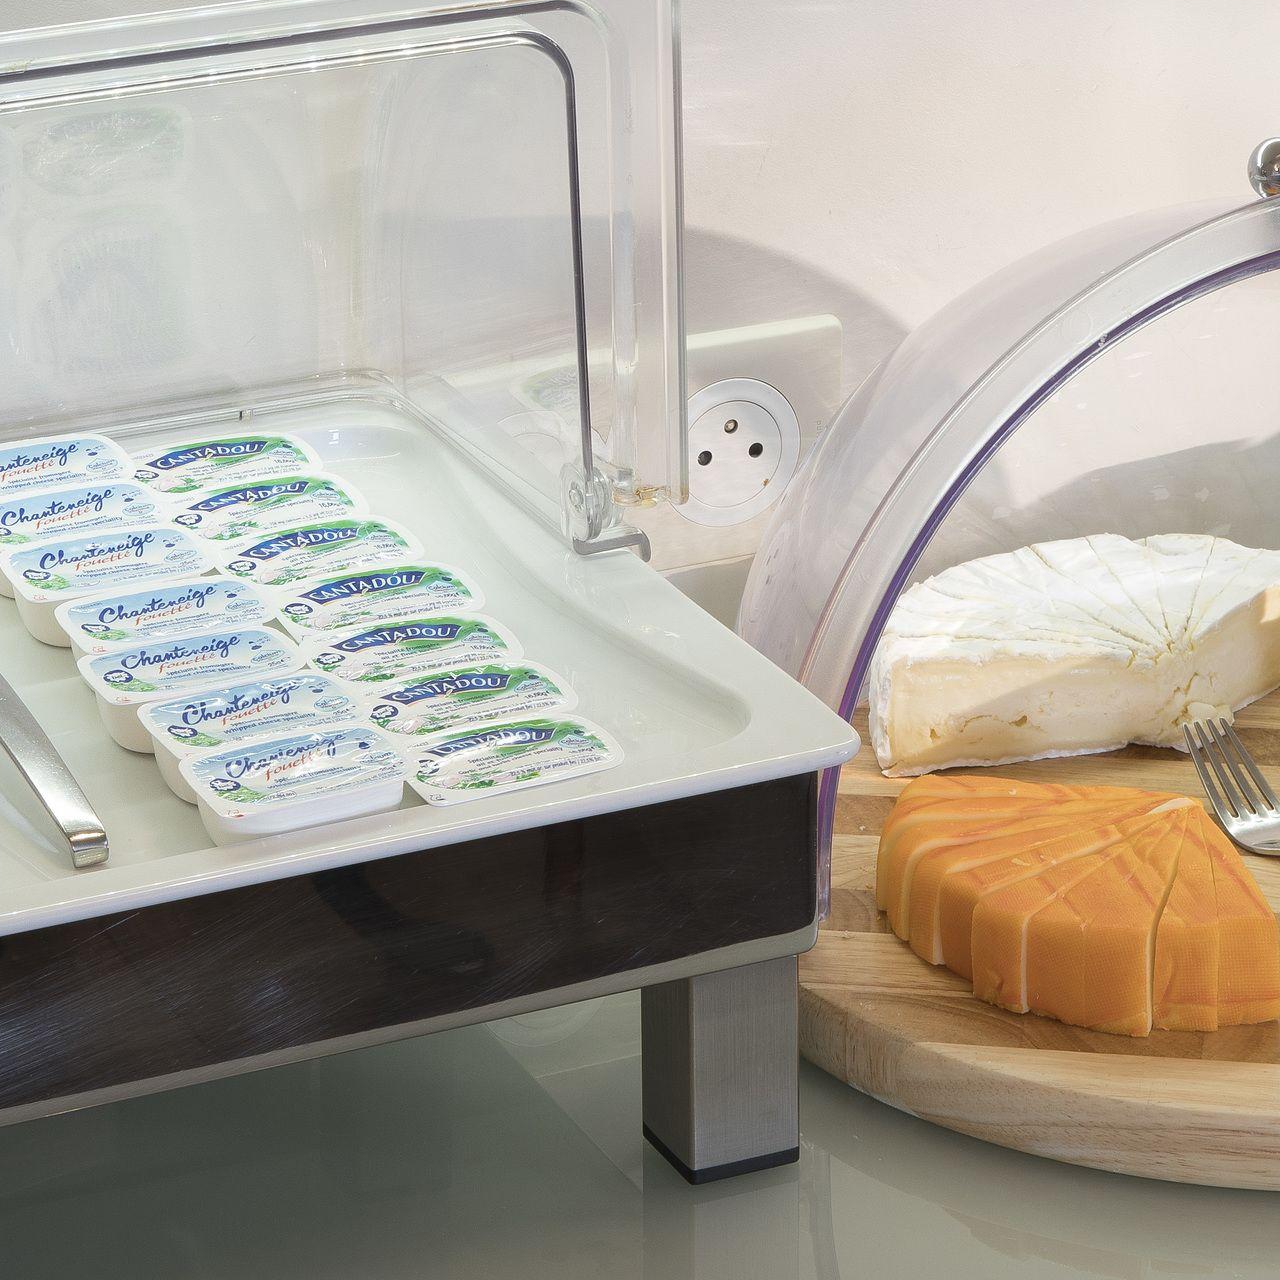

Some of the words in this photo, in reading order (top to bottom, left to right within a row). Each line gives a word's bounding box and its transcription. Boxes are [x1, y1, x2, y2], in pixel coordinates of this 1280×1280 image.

[156, 441, 258, 469] CANTADOU
[1, 459, 56, 482] fouetté
[55, 472, 87, 484] speciality
[1, 488, 114, 527] Chanteneige
[198, 482, 302, 511] CANTADOU
[34, 505, 91, 528] fouetté
[91, 516, 123, 528] speciality
[39, 531, 155, 569] Chanteneige
[249, 528, 352, 558] CANTADOU
[75, 549, 131, 571] fouetté
[309, 572, 417, 601] CANTADOU
[98, 585, 218, 623] Chanteneige
[134, 603, 192, 625] fouetté
[342, 627, 451, 651] CANTADOU
[121, 635, 241, 670] Chanteneige
[159, 652, 217, 674] fouetté
[392, 676, 501, 701] CANTADOU
[221, 699, 278, 725] fouetté
[223, 723, 256, 735] Whipped
[282, 711, 316, 724] speciality
[434, 730, 546, 753] CANTADOU
